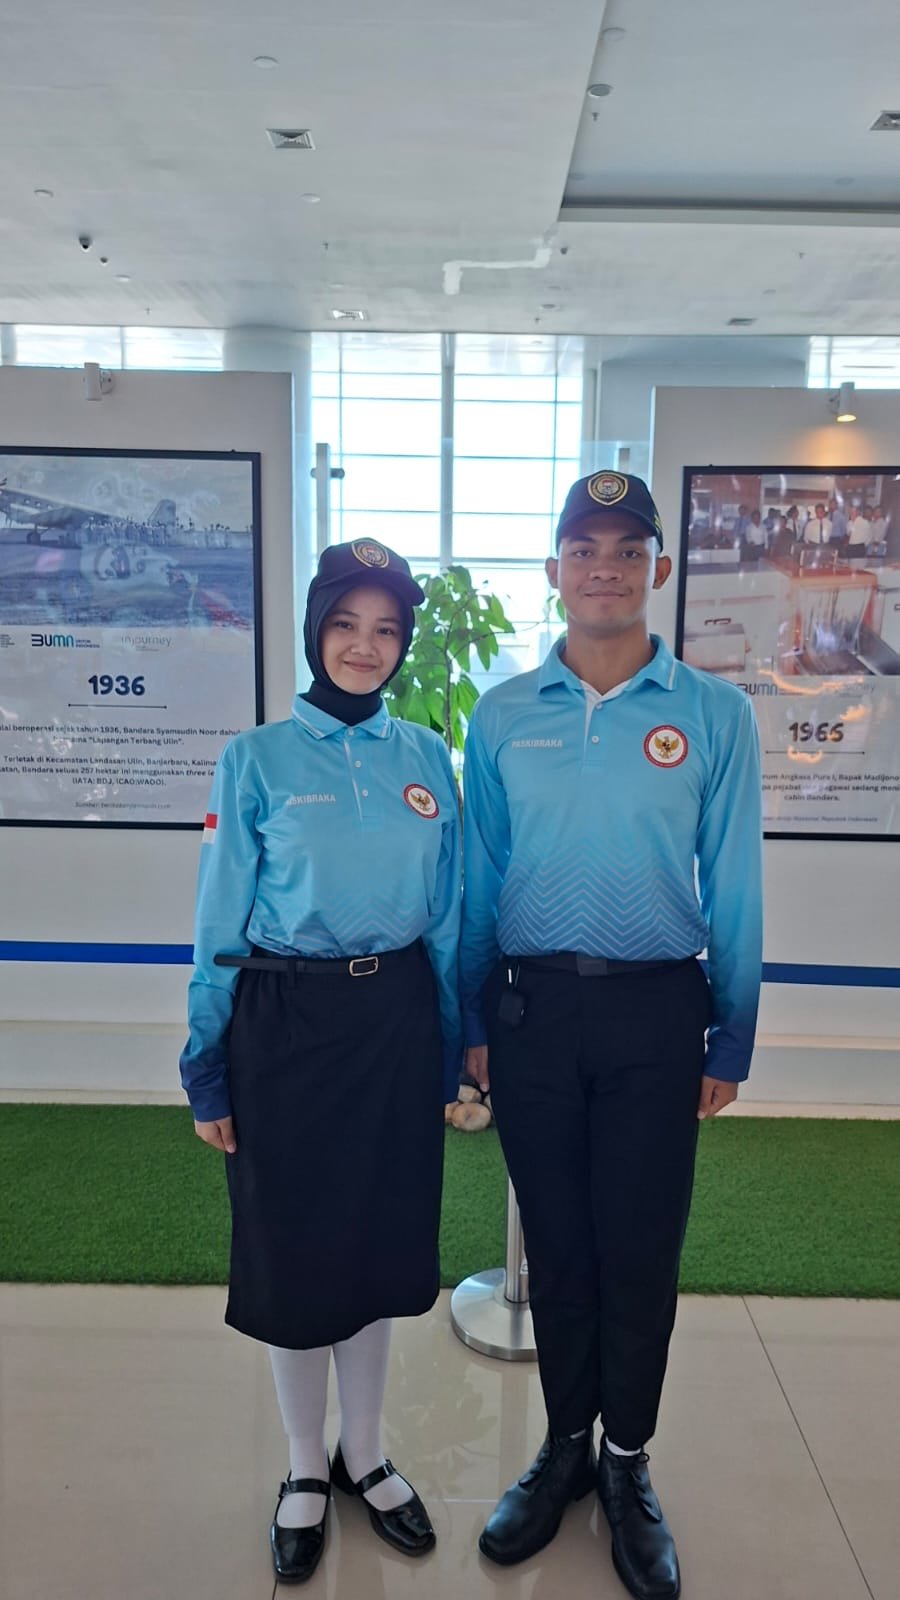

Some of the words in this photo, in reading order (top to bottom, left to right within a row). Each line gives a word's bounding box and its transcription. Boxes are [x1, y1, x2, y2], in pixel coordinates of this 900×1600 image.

[88, 675, 145, 696] 1936
[13, 725, 54, 733] beroperasi
[512, 738, 563, 748] PASKIBRAKA
